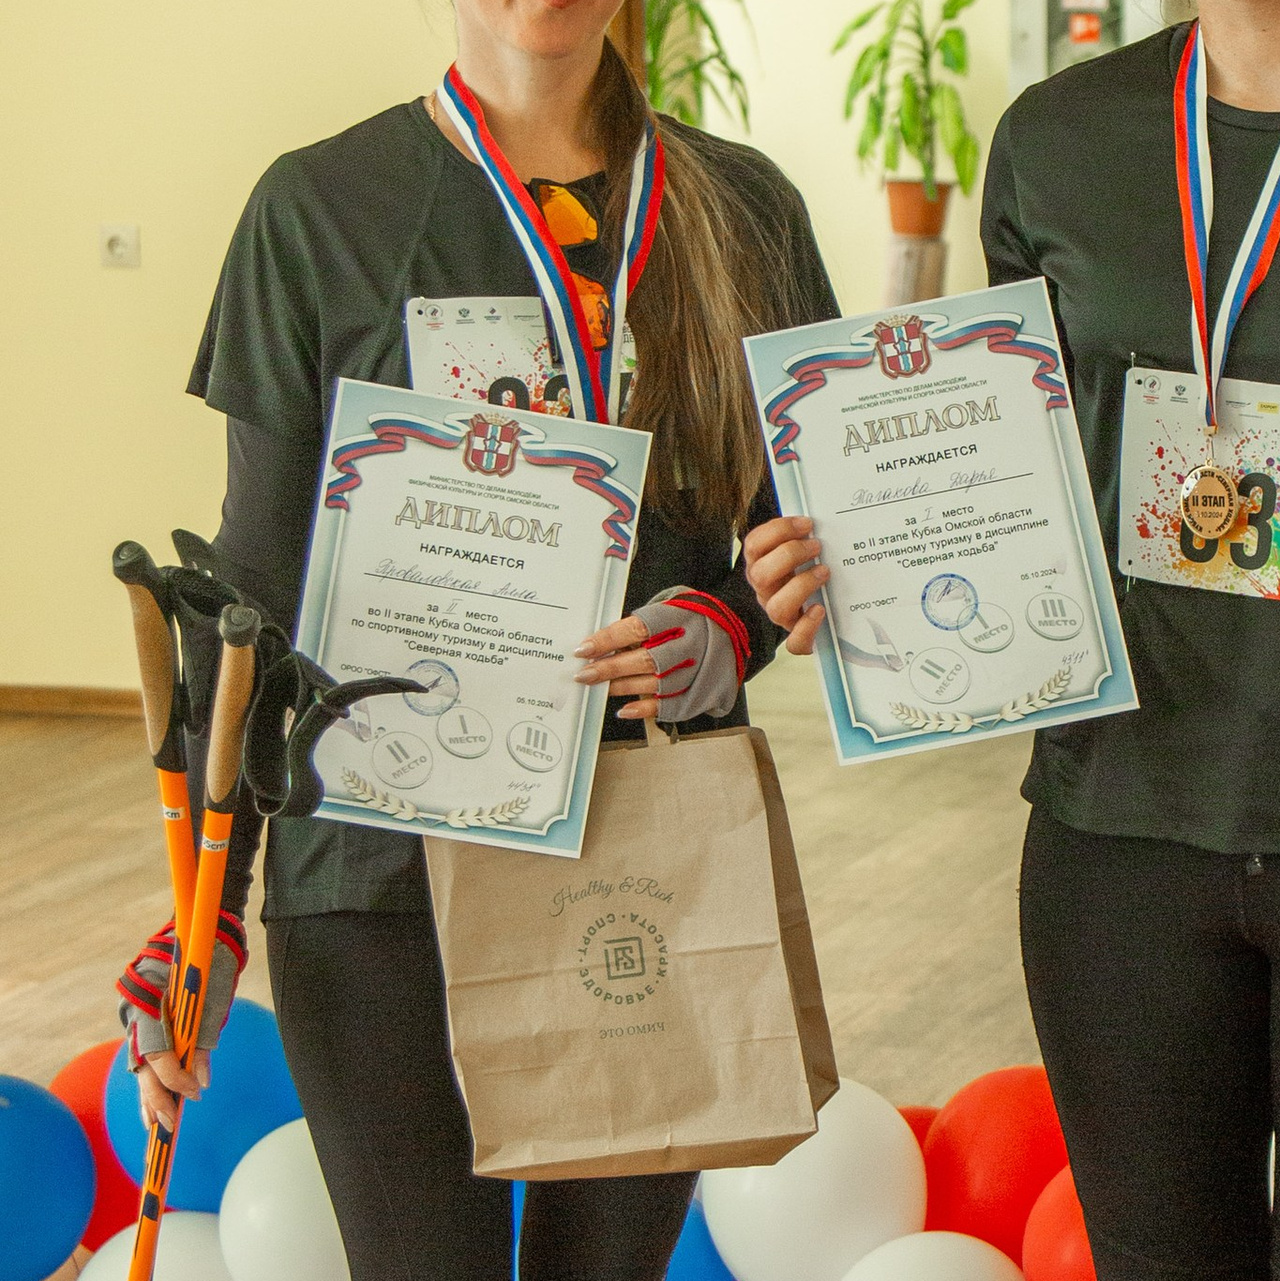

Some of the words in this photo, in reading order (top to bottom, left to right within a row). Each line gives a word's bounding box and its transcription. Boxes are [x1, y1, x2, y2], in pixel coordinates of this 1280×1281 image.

[841, 402, 879, 413] ФИЗИЧЕСКОЙ
[880, 396, 907, 407] КУЛЬТУРЫ
[913, 390, 934, 400] СПОРТА
[936, 385, 960, 396] ОМСКОЙ
[961, 380, 987, 391] ОБЛАСТИ
[858, 388, 903, 402] МИНИСТЕРСТВО
[913, 383, 933, 393] ДЕЛАМ
[843, 396, 1001, 456] ДИПЛОМ
[876, 444, 977, 473] НАГРАЖДАЕТСЯ
[408, 479, 447, 491] ФИЗИЧЕСКОЙ
[448, 486, 476, 496] КУЛЬТУРЫ
[483, 492, 505, 502] СПОРТА
[507, 496, 532, 505] ОМСКОЙ
[533, 501, 559, 510] ОБЛАСТИ
[430, 475, 475, 489] МИНИСТЕРСТВО
[484, 484, 507, 494] ДЕЛАМ
[1192, 496, 1198, 506] II
[1202, 496, 1225, 507] ЭТАП
[395, 496, 562, 547] ДИПЛОМ
[853, 541, 866, 550] во
[879, 533, 909, 547] этапе
[911, 526, 942, 540] Кубка
[944, 516, 985, 532] Омской
[988, 508, 1032, 524] области
[905, 517, 917, 526] за
[942, 506, 974, 518] место
[843, 557, 855, 566] по
[858, 543, 926, 564] спортивному
[930, 533, 972, 551] туризму
[976, 532, 982, 540] в
[985, 519, 1049, 540] дисциплине
[897, 551, 955, 569] "Северная
[957, 541, 999, 559] ходьба"
[420, 543, 524, 569] НАГРАЖДАЕТСЯ
[1020, 568, 1057, 581] 05.10.2024
[427, 604, 439, 613] за
[466, 611, 498, 623] место
[850, 601, 871, 612] ОРОО
[368, 608, 381, 617] во
[394, 612, 425, 625] этапе
[429, 616, 459, 631] Кубка
[463, 623, 505, 638] Омской
[507, 632, 553, 646] области
[973, 623, 1008, 644] МЕСТО
[1038, 619, 1077, 627] МЕСТО
[351, 619, 364, 628] по
[368, 622, 438, 642] спортивному
[443, 635, 486, 651] туризму
[489, 642, 495, 650] в
[498, 644, 564, 662] дисциплине
[404, 640, 462, 659] "Северная
[465, 651, 509, 666] ходьба"
[340, 663, 363, 674] ОРОО
[935, 663, 962, 696] МЕСТО
[517, 696, 554, 709] 05.10.2024
[449, 735, 487, 744] МЕСТО
[516, 744, 553, 762] МЕСТО
[392, 755, 428, 779] МЕСТО
[549, 879, 616, 917] Healthy
[619, 876, 634, 893] &
[634, 877, 675, 904] Rich
[578, 913, 616, 956] СПОРТ
[630, 913, 669, 978] КРАСОТА
[579, 968, 655, 1006] ЗДОРОВЬЕ
